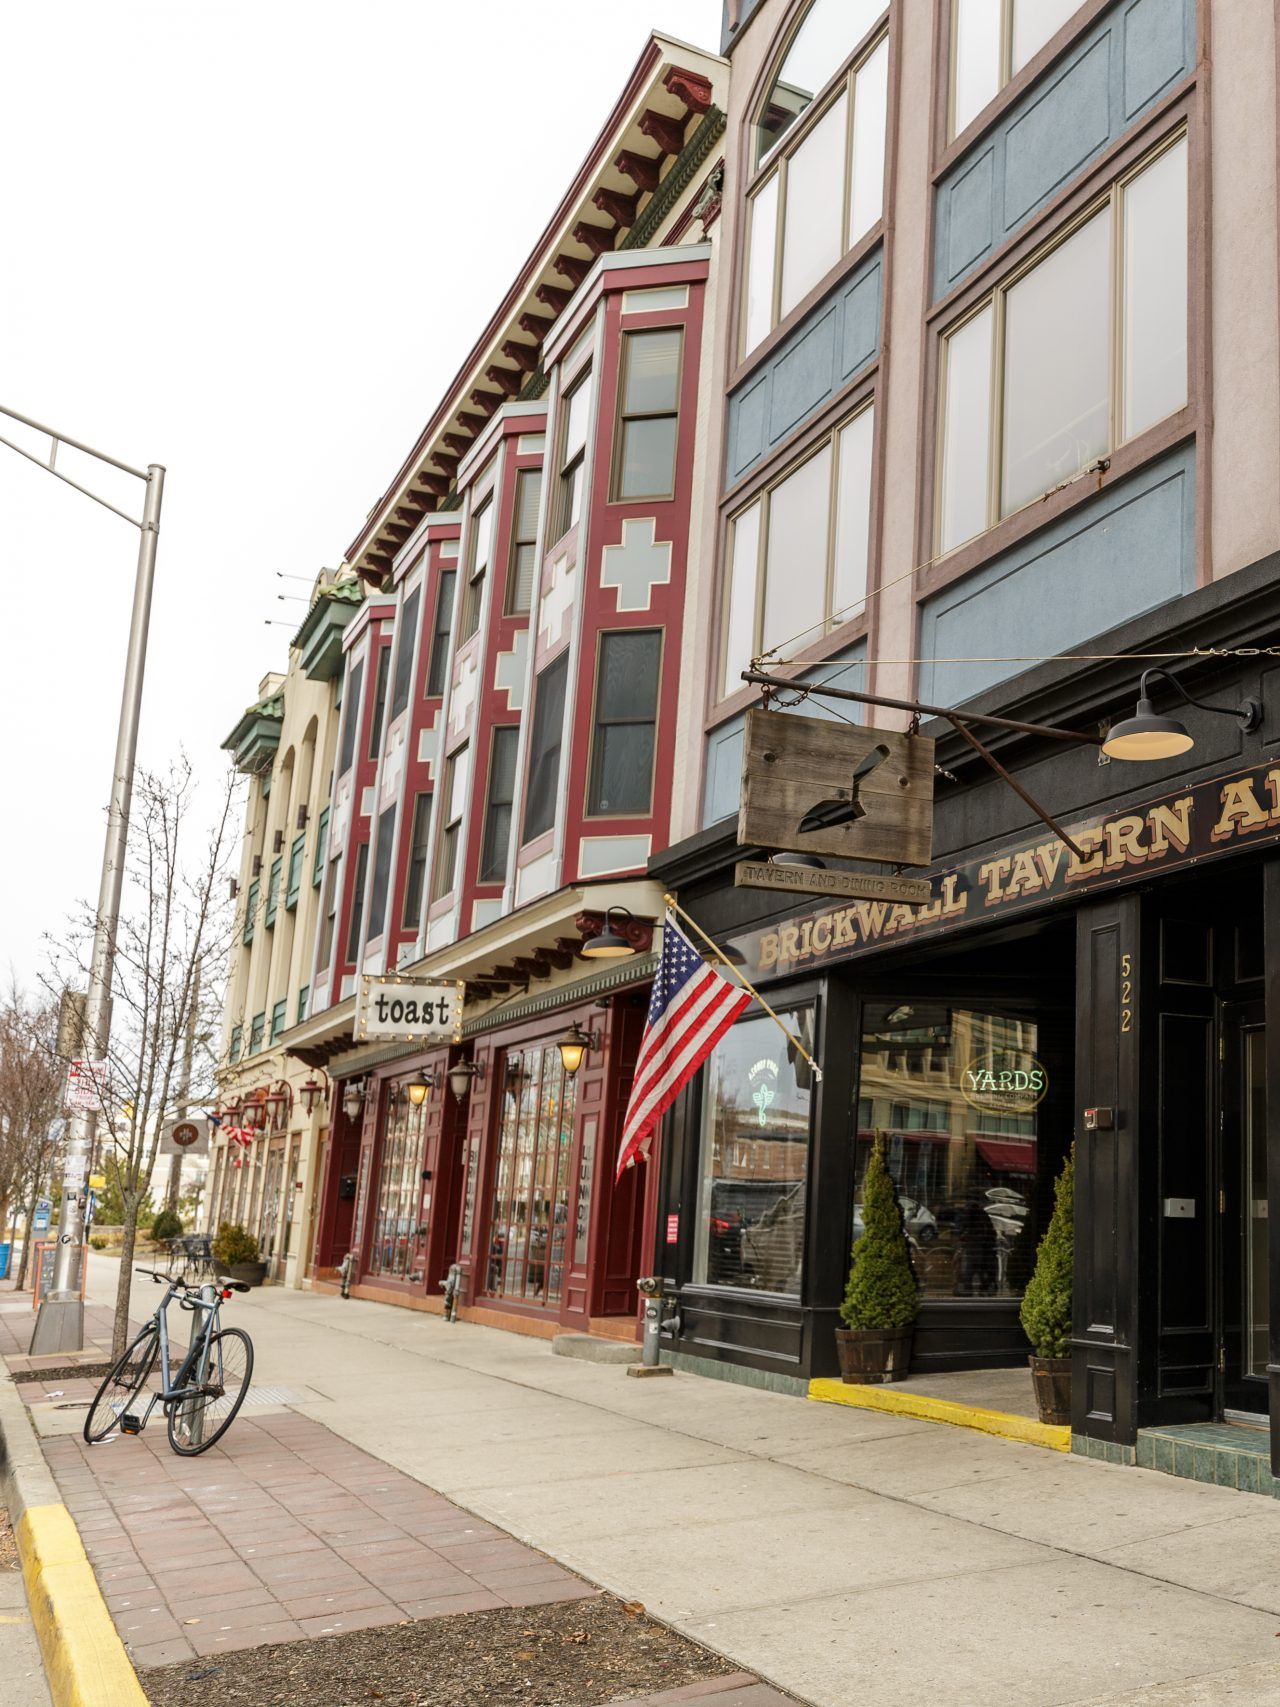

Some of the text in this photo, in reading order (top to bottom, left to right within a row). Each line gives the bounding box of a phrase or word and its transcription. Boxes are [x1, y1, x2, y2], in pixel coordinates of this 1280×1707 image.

[746, 866, 928, 896] TAVERN AND DINING ROOM
[758, 873, 969, 971] BRICKWALL
[978, 796, 1194, 907] TAVERN
[375, 993, 449, 1025] toast
[1122, 954, 1131, 1032] 522
[966, 1069, 1043, 1091] YARDS
[576, 1145, 588, 1240] LUNCH
